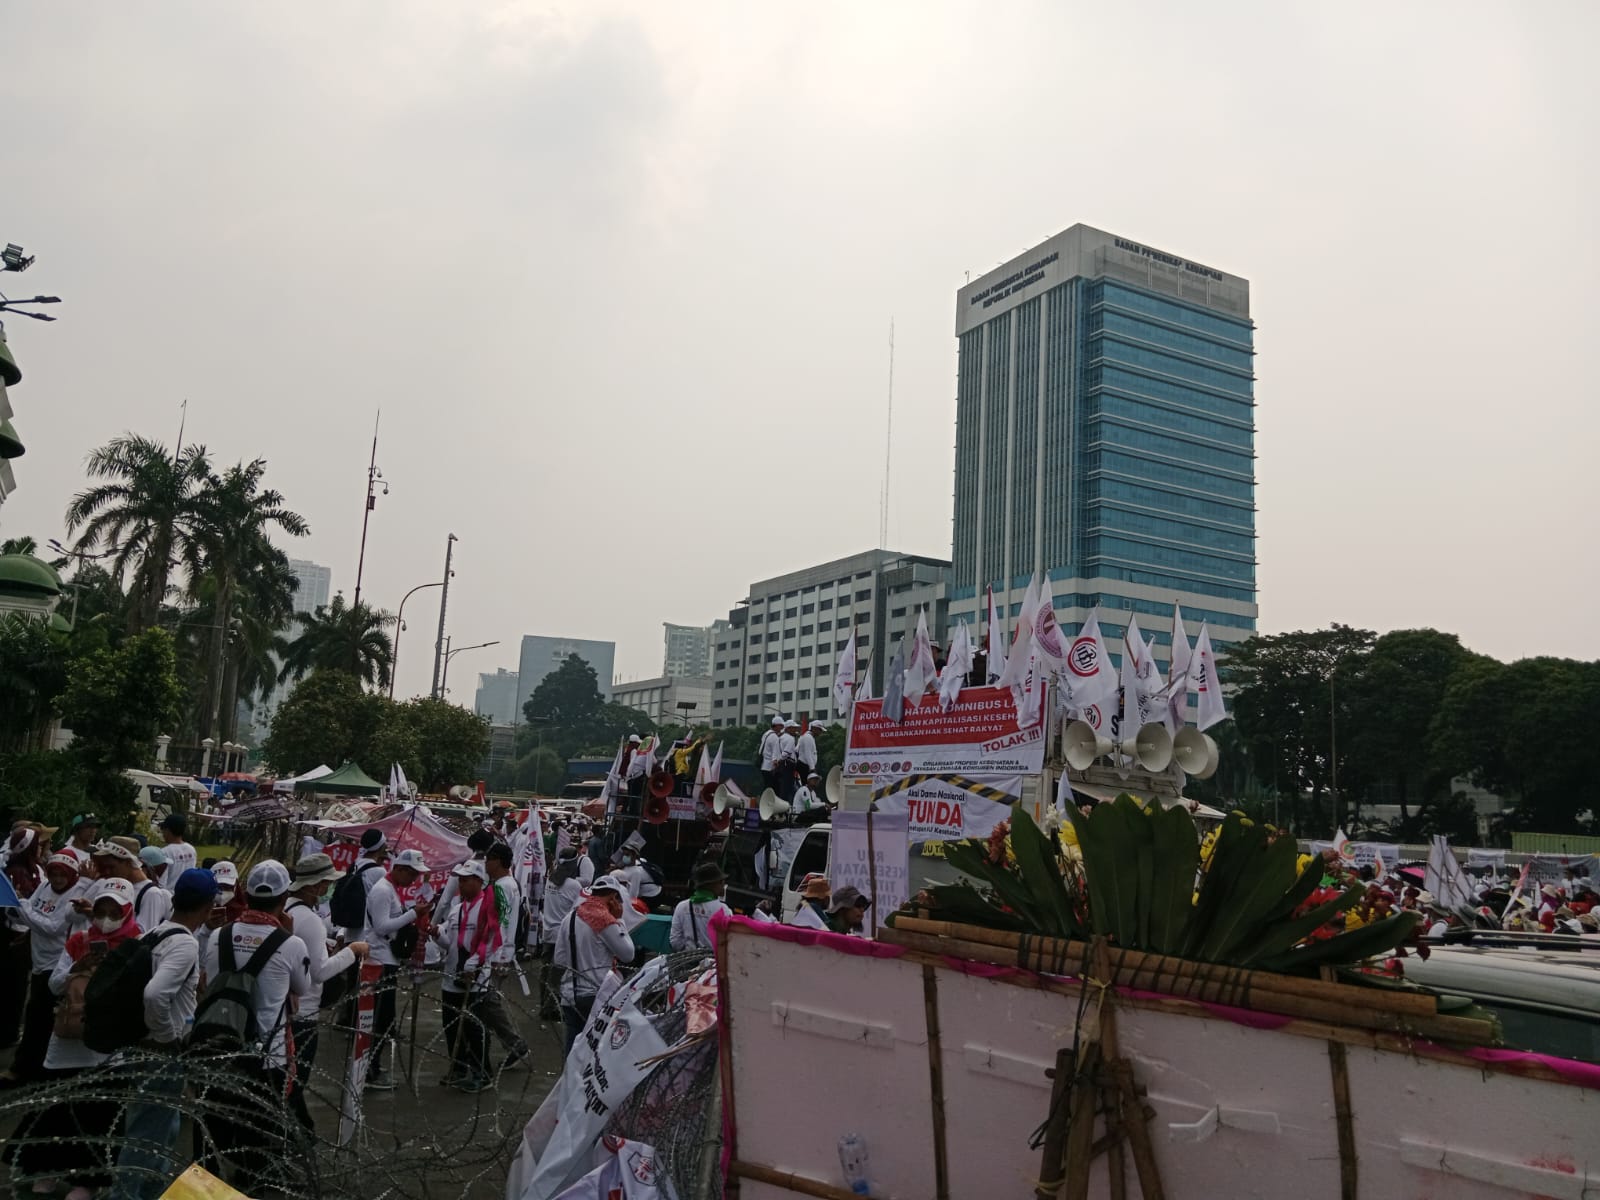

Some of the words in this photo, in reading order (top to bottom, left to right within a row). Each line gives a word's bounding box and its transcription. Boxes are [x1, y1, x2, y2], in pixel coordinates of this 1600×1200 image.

[860, 712, 878, 721] RUU
[922, 715, 981, 726] KAPITALISASI
[880, 729, 924, 738] KORBANKAN
[943, 726, 969, 734] SEHAT
[982, 733, 1026, 752] TOLAK
[908, 789, 919, 798] Aksi
[937, 790, 965, 801] Nasional
[907, 799, 962, 828] TUNDA
[934, 827, 961, 837] Kesehatan
